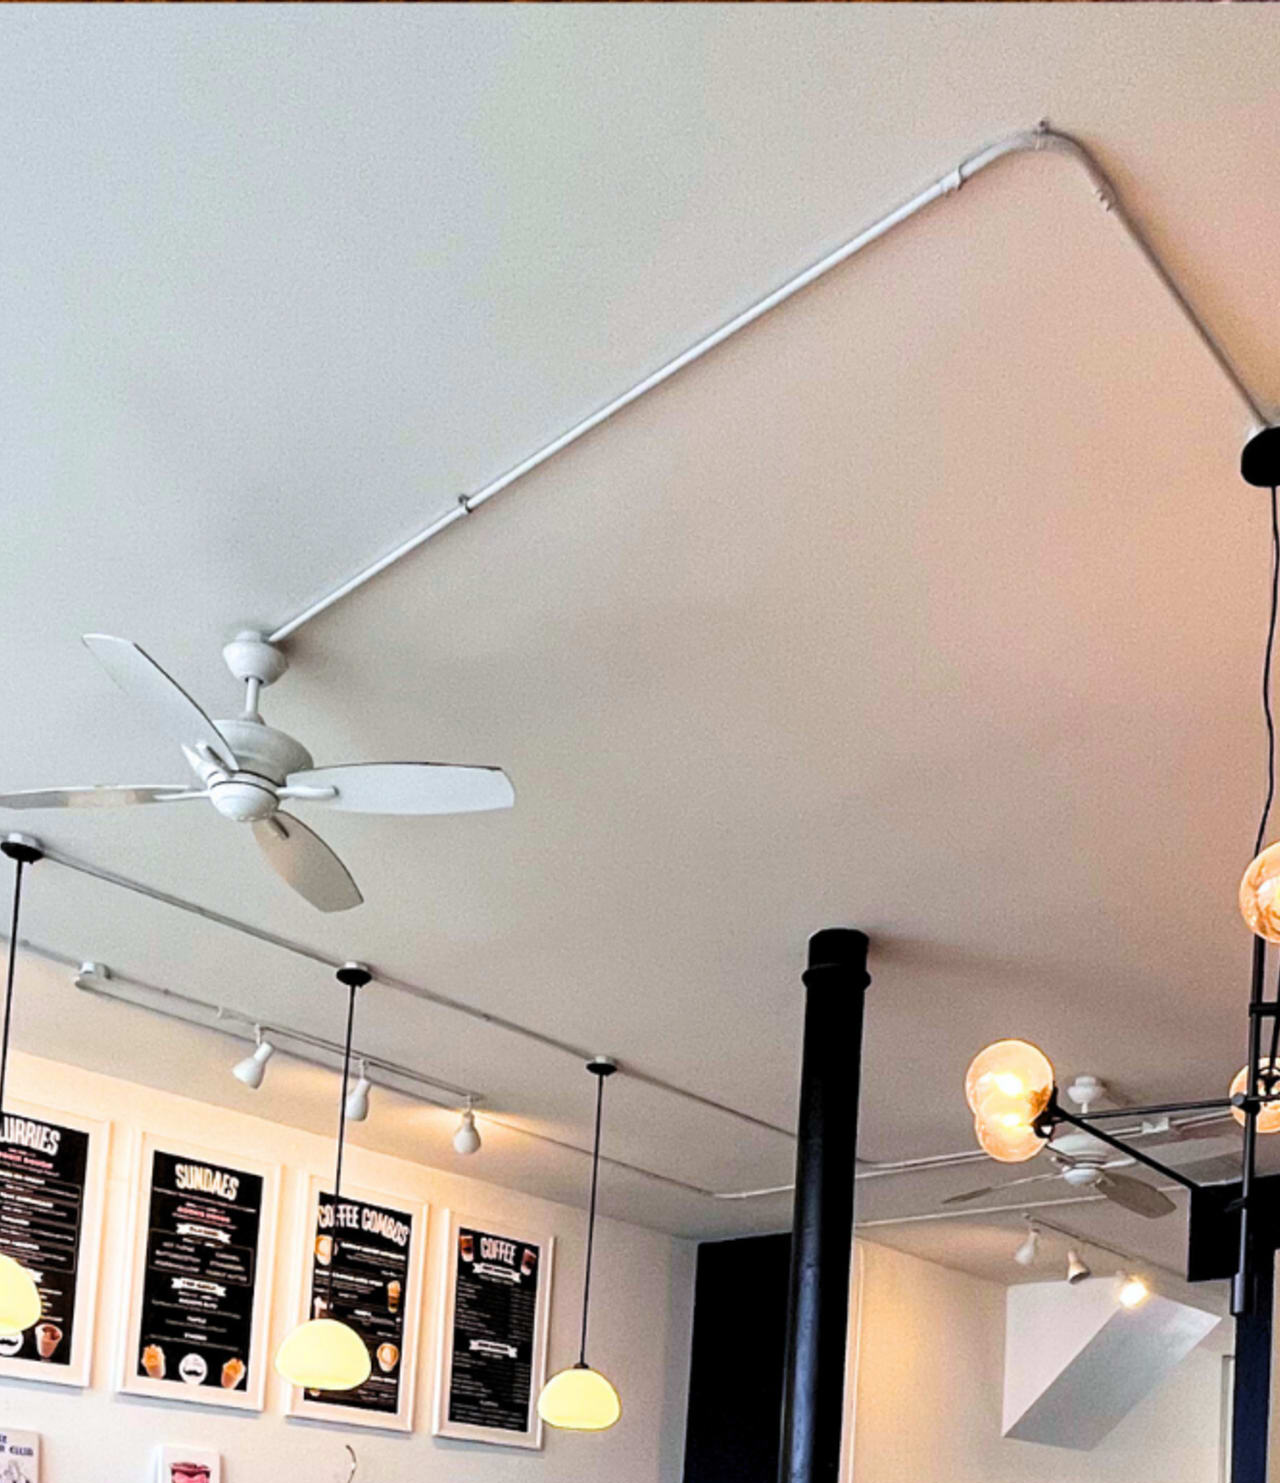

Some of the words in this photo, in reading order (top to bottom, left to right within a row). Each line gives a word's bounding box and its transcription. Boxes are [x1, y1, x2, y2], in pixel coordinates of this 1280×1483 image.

[174, 1163, 240, 1201] SUNDAES
[319, 1202, 360, 1230] COFEE
[361, 1207, 410, 1247] COMBOS
[480, 1236, 517, 1267] COFFEE
